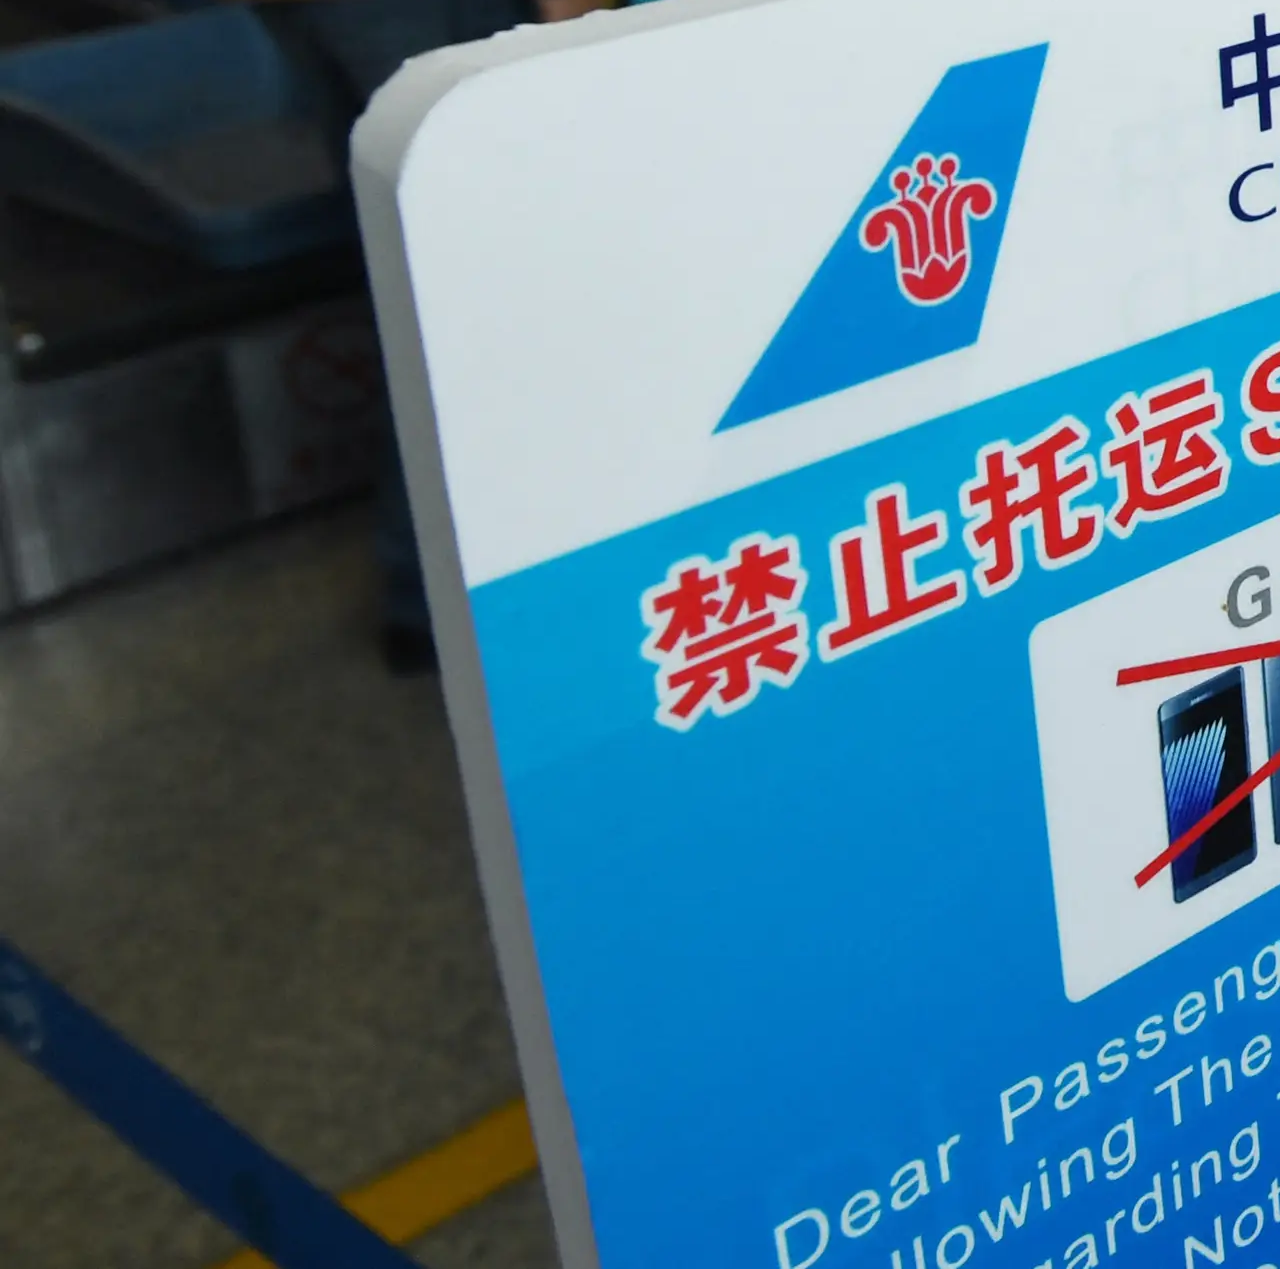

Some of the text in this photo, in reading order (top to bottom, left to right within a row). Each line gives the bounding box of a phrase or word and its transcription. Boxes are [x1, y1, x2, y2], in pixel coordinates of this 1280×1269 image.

[648, 374, 1228, 724] 禁止托运
[1153, 1034, 1273, 1127] The
[773, 1133, 961, 1269] Dear
[1033, 1120, 1261, 1269] arding
